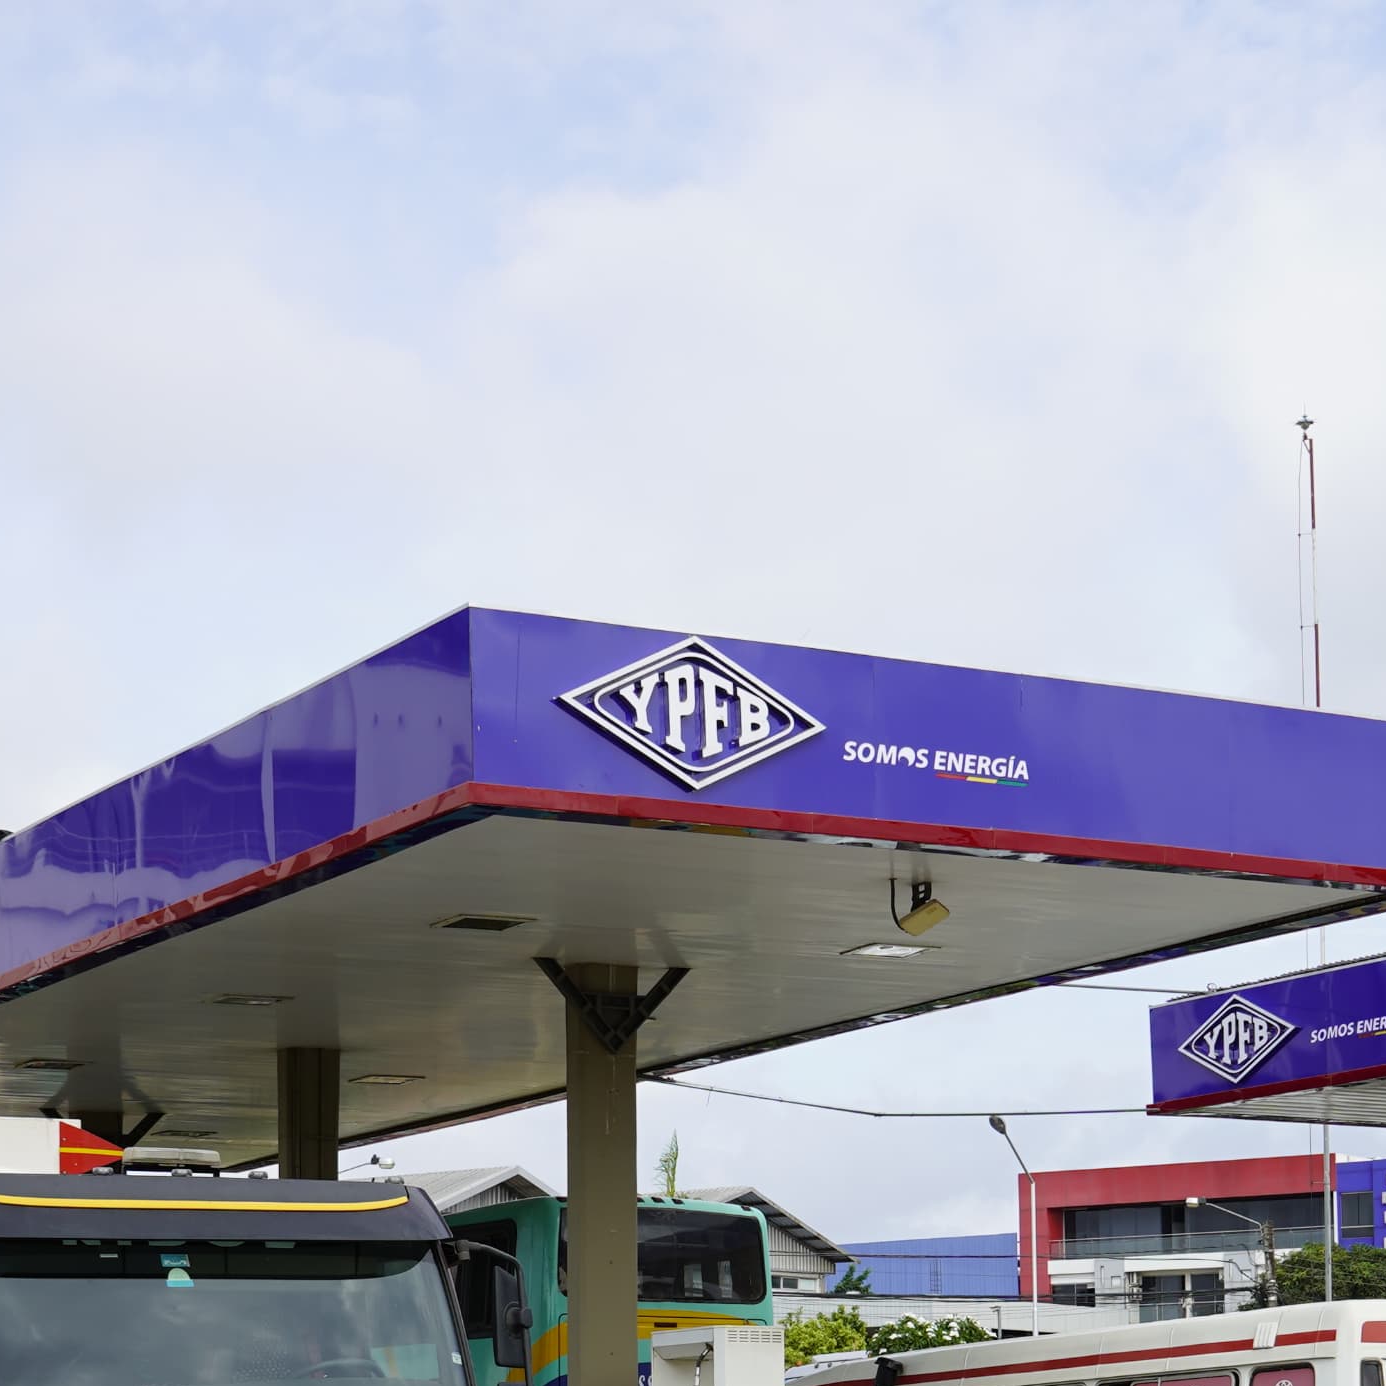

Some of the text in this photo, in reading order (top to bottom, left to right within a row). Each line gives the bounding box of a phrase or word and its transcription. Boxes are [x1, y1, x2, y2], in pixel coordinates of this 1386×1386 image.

[619, 663, 771, 759] YPFB
[843, 740, 1030, 782] SOMOS ENERGÍA
[1204, 1012, 1269, 1065] YPFB
[1310, 1022, 1354, 1044] SOMOS
